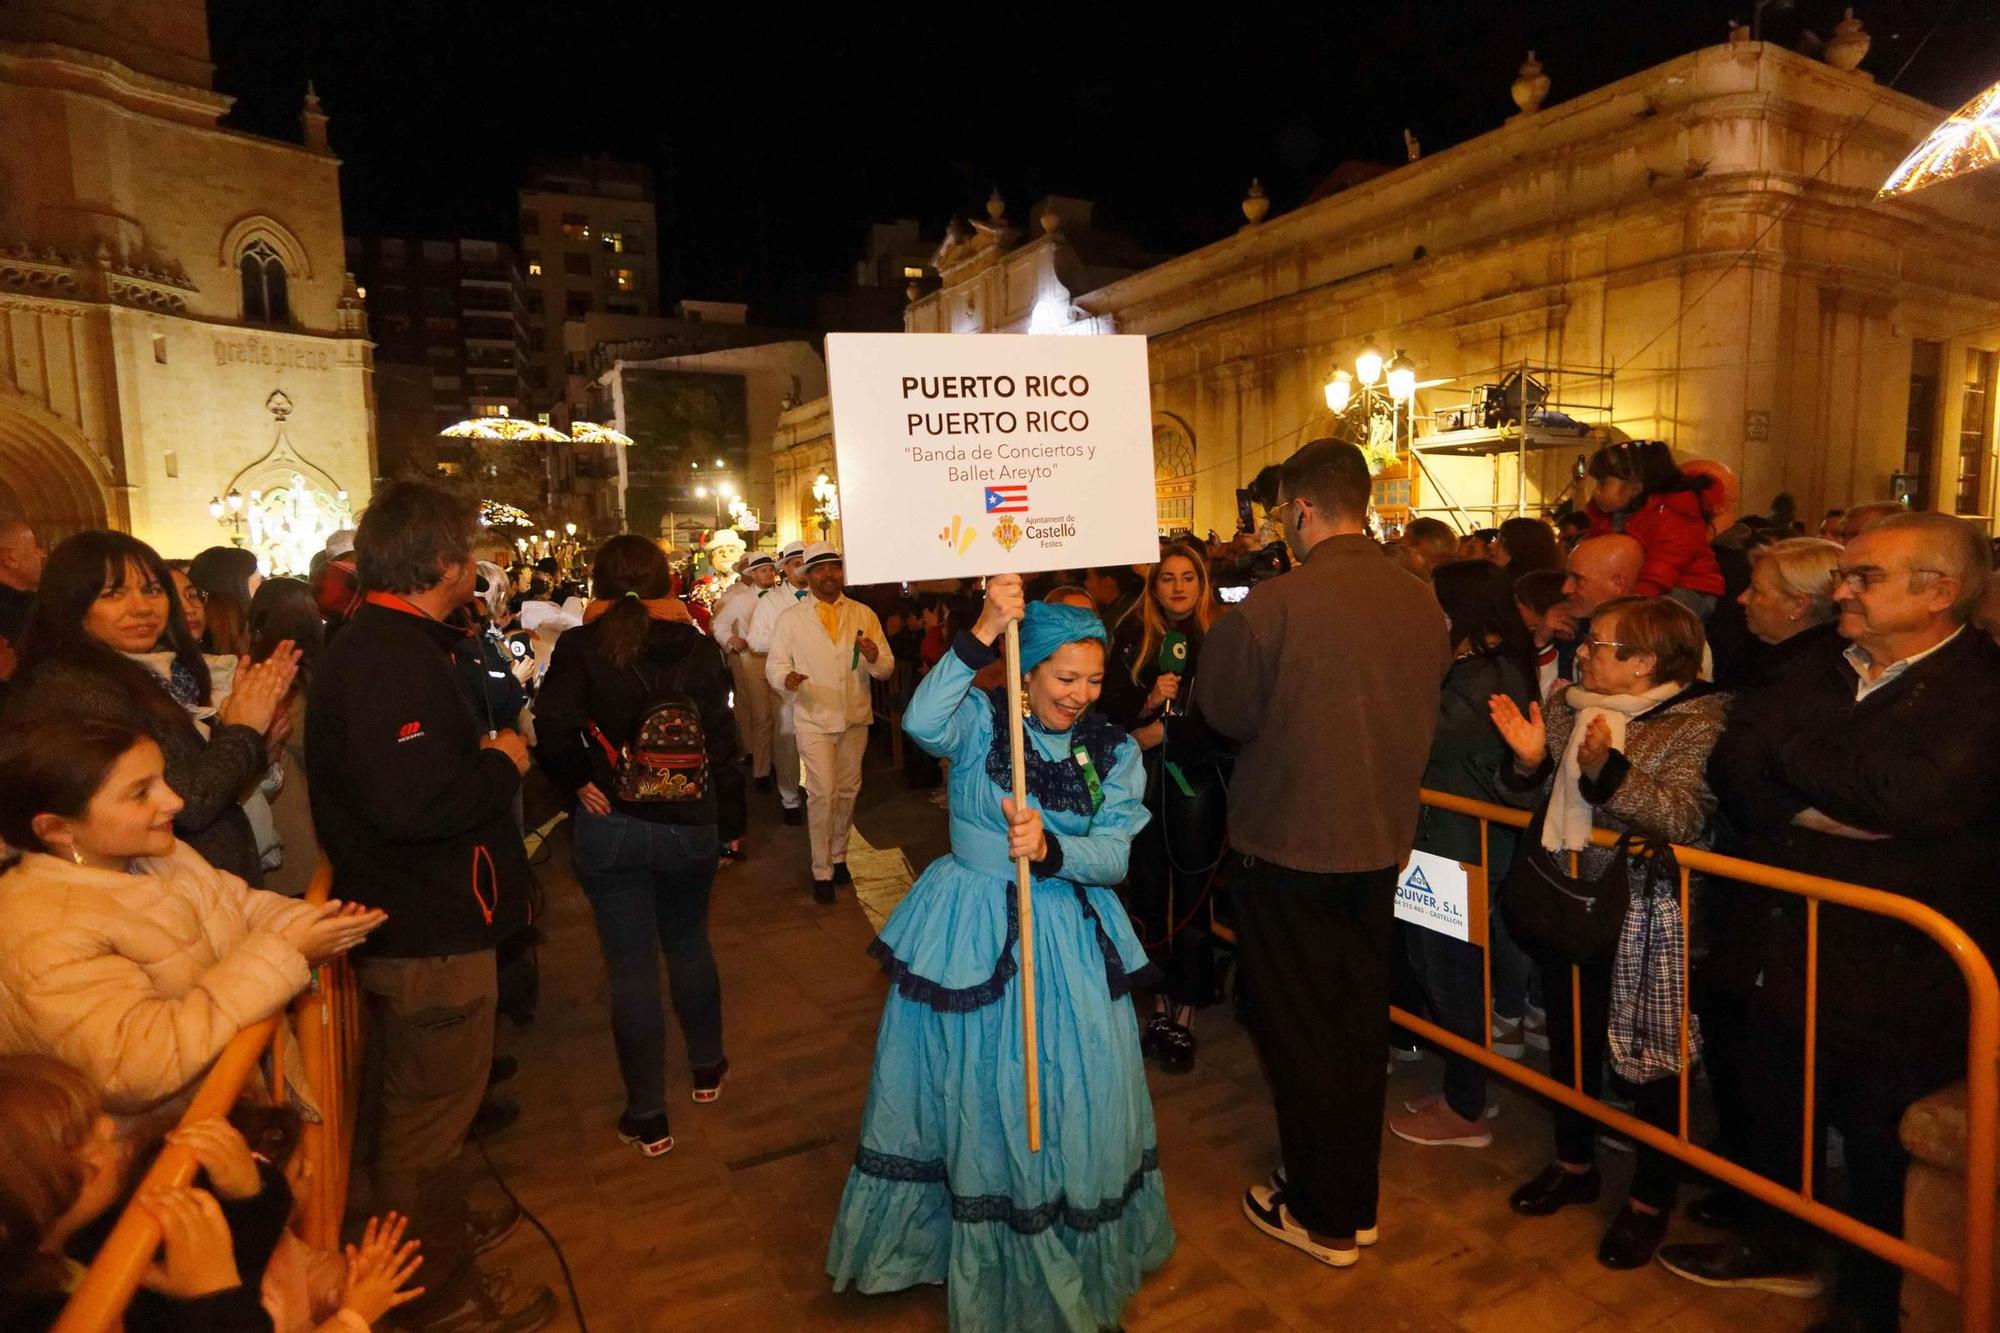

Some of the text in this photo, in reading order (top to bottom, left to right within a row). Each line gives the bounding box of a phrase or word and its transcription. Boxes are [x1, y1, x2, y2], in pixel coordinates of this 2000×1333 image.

[902, 374, 1089, 399] PUERTO RICO
[907, 410, 1089, 435] PUERTO RICO
[905, 443, 1096, 462] "Banda de Conciertos y
[948, 463, 1058, 483] Ballet Areyto"
[1025, 514, 1076, 525] Ajuntament de
[1025, 523, 1076, 539] Castelló
[1040, 540, 1063, 549] Festes
[1443, 901, 1462, 916] S.L.
[1429, 911, 1463, 926] CASTELLON
